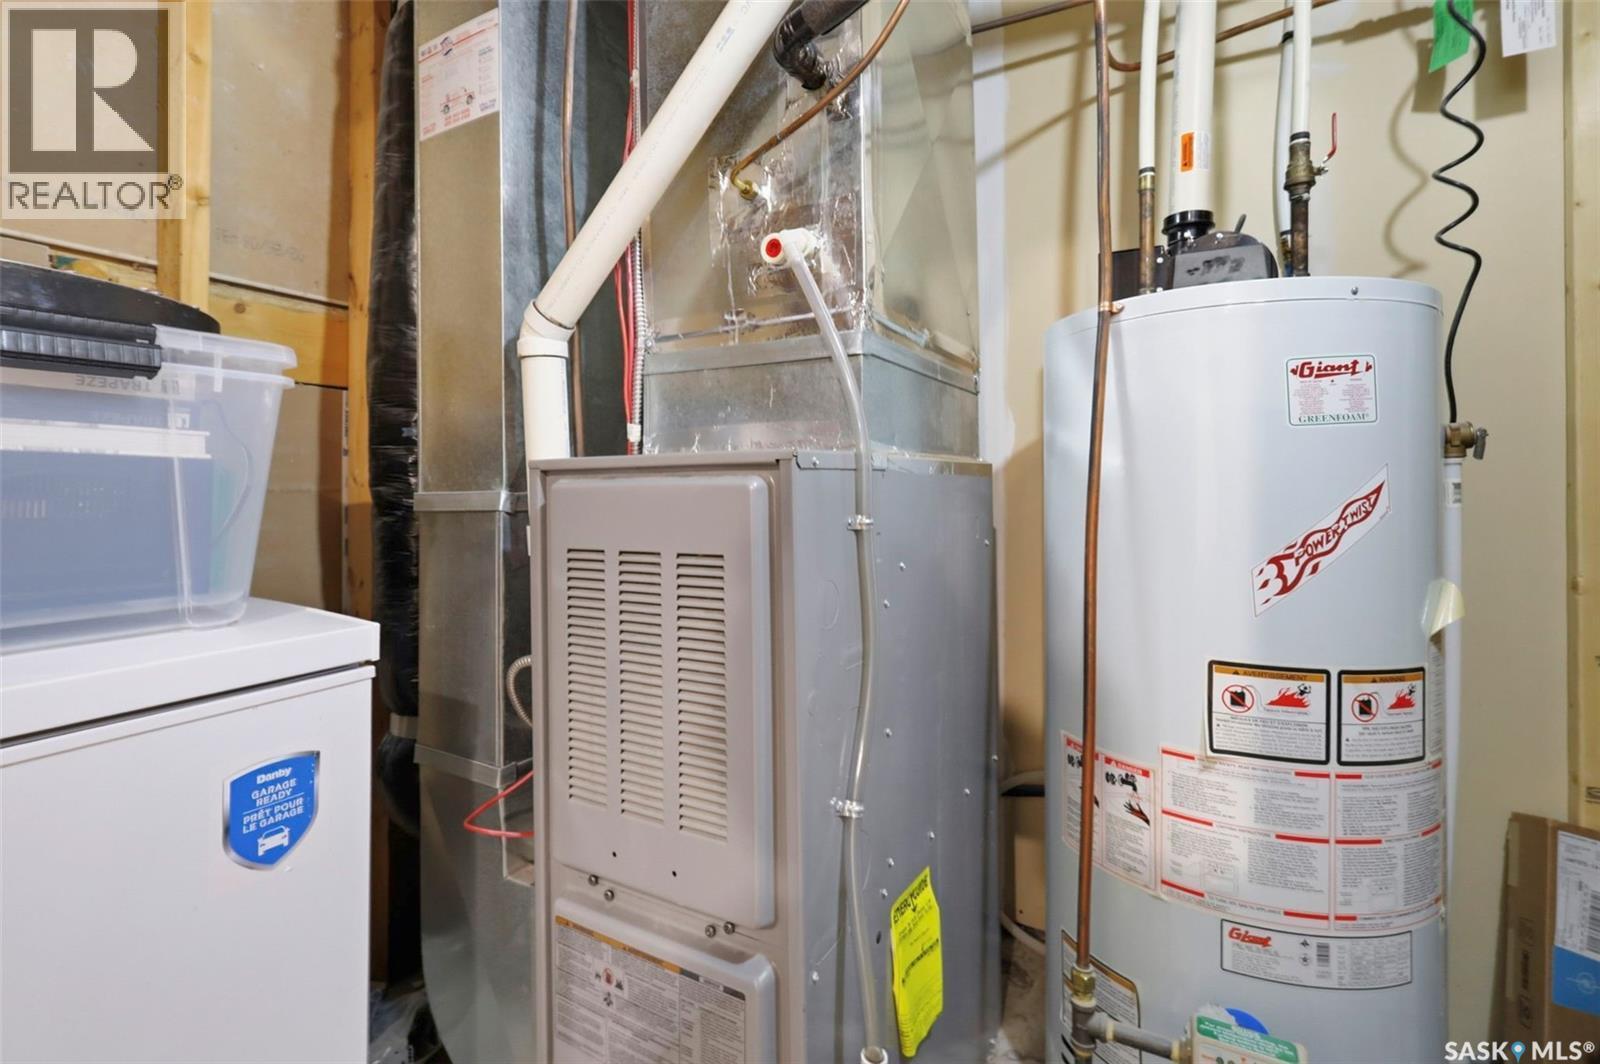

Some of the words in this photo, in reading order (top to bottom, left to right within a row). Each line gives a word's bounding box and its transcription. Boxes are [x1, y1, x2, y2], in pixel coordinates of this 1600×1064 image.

[1298, 359, 1363, 379] Giant
[1294, 524, 1343, 567] POWER
[1340, 497, 1375, 526] TWIST
[256, 767, 292, 784] Danby
[251, 778, 297, 800] GARAGE
[256, 788, 293, 807] READY
[242, 807, 273, 825] PRÊT
[273, 797, 304, 814] POUR
[242, 822, 258, 834] LE
[259, 806, 304, 828] GARAGE
